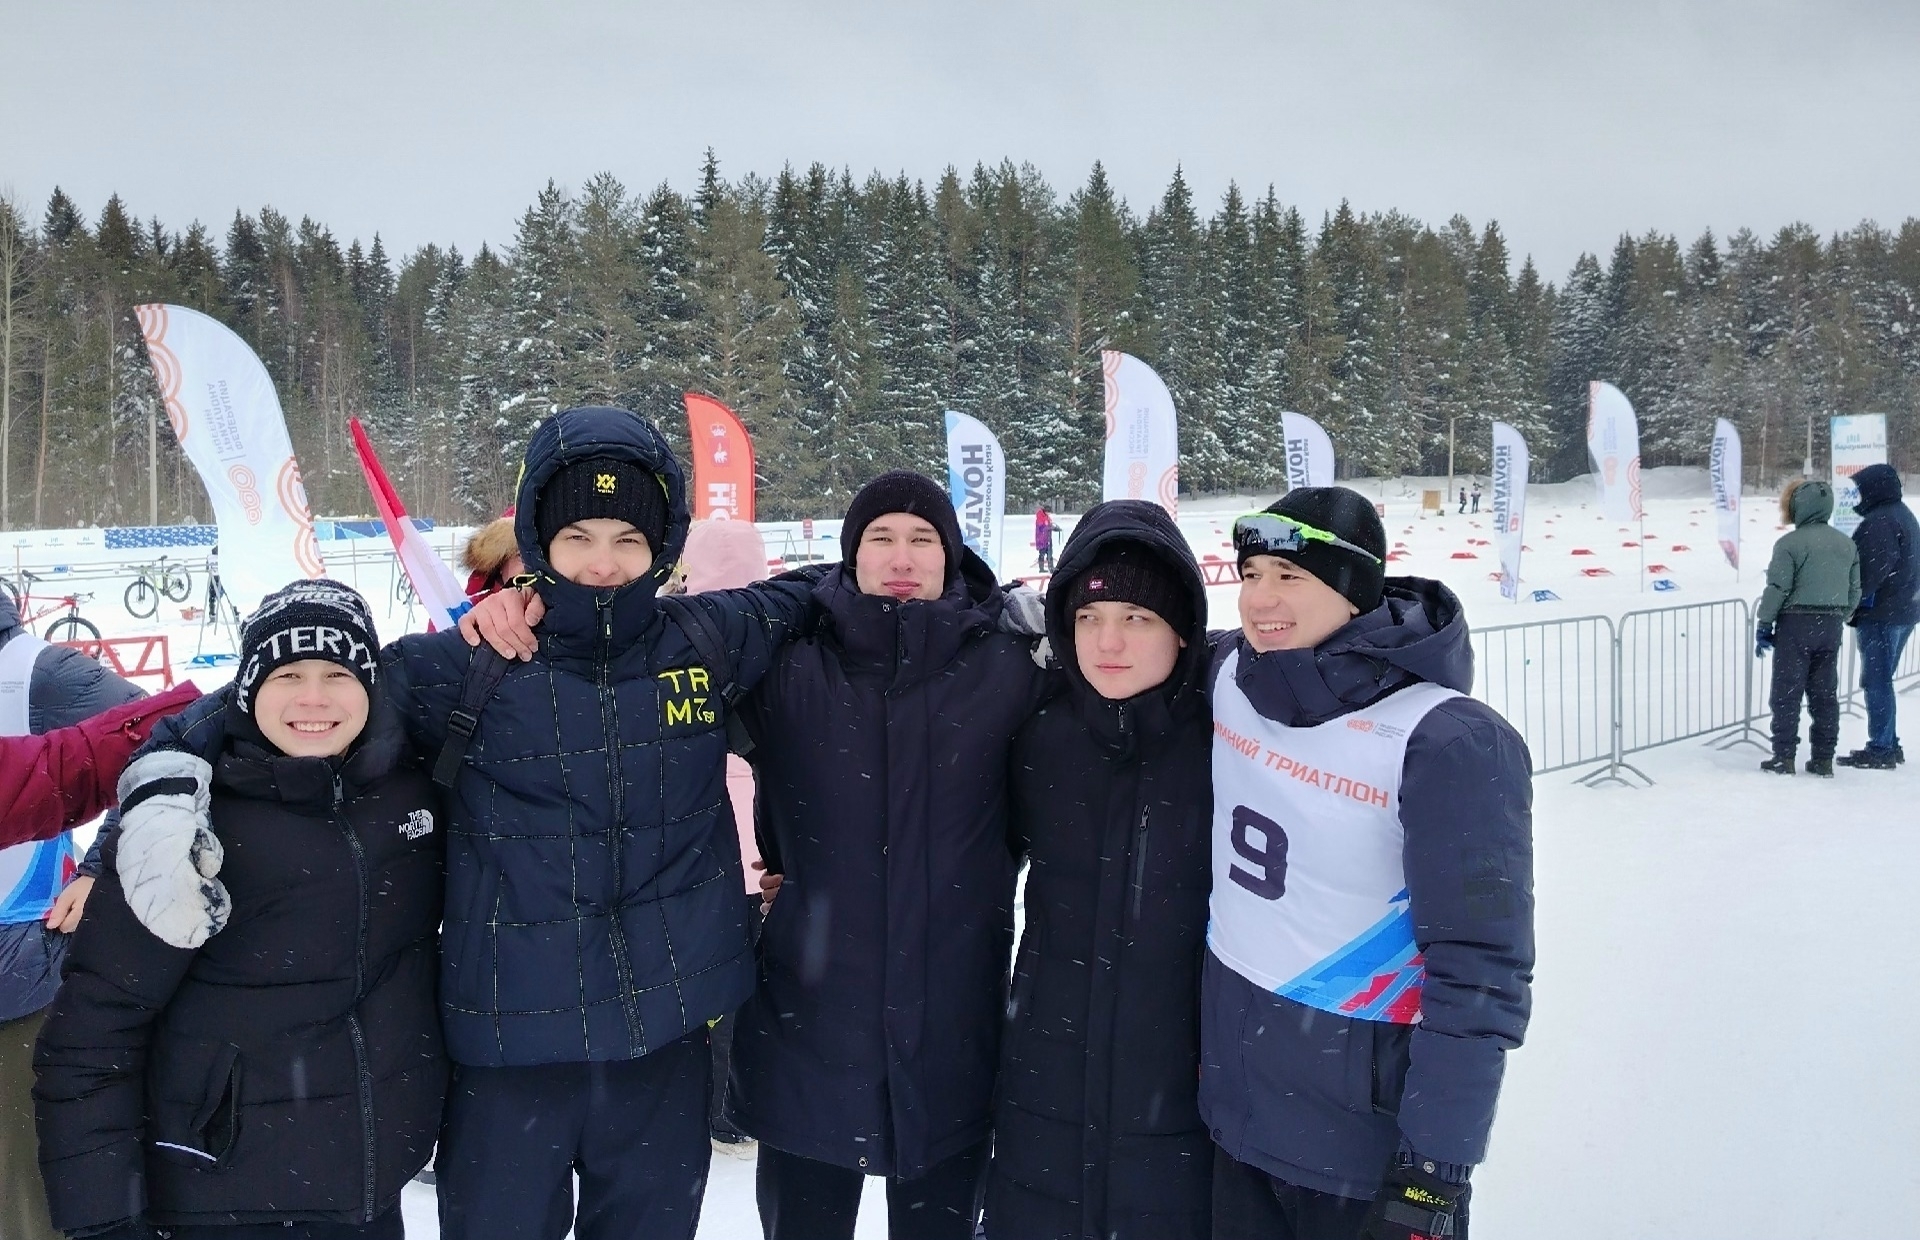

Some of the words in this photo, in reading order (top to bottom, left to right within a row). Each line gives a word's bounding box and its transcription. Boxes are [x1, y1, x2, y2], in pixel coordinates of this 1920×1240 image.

[1213, 719, 1261, 760] ИМНИЙ
[1265, 750, 1389, 808] ТРИАТЛОН
[408, 810, 422, 821] THE
[399, 820, 423, 834] NORTH
[407, 828, 423, 841] FACE
[1229, 805, 1289, 901] 9
